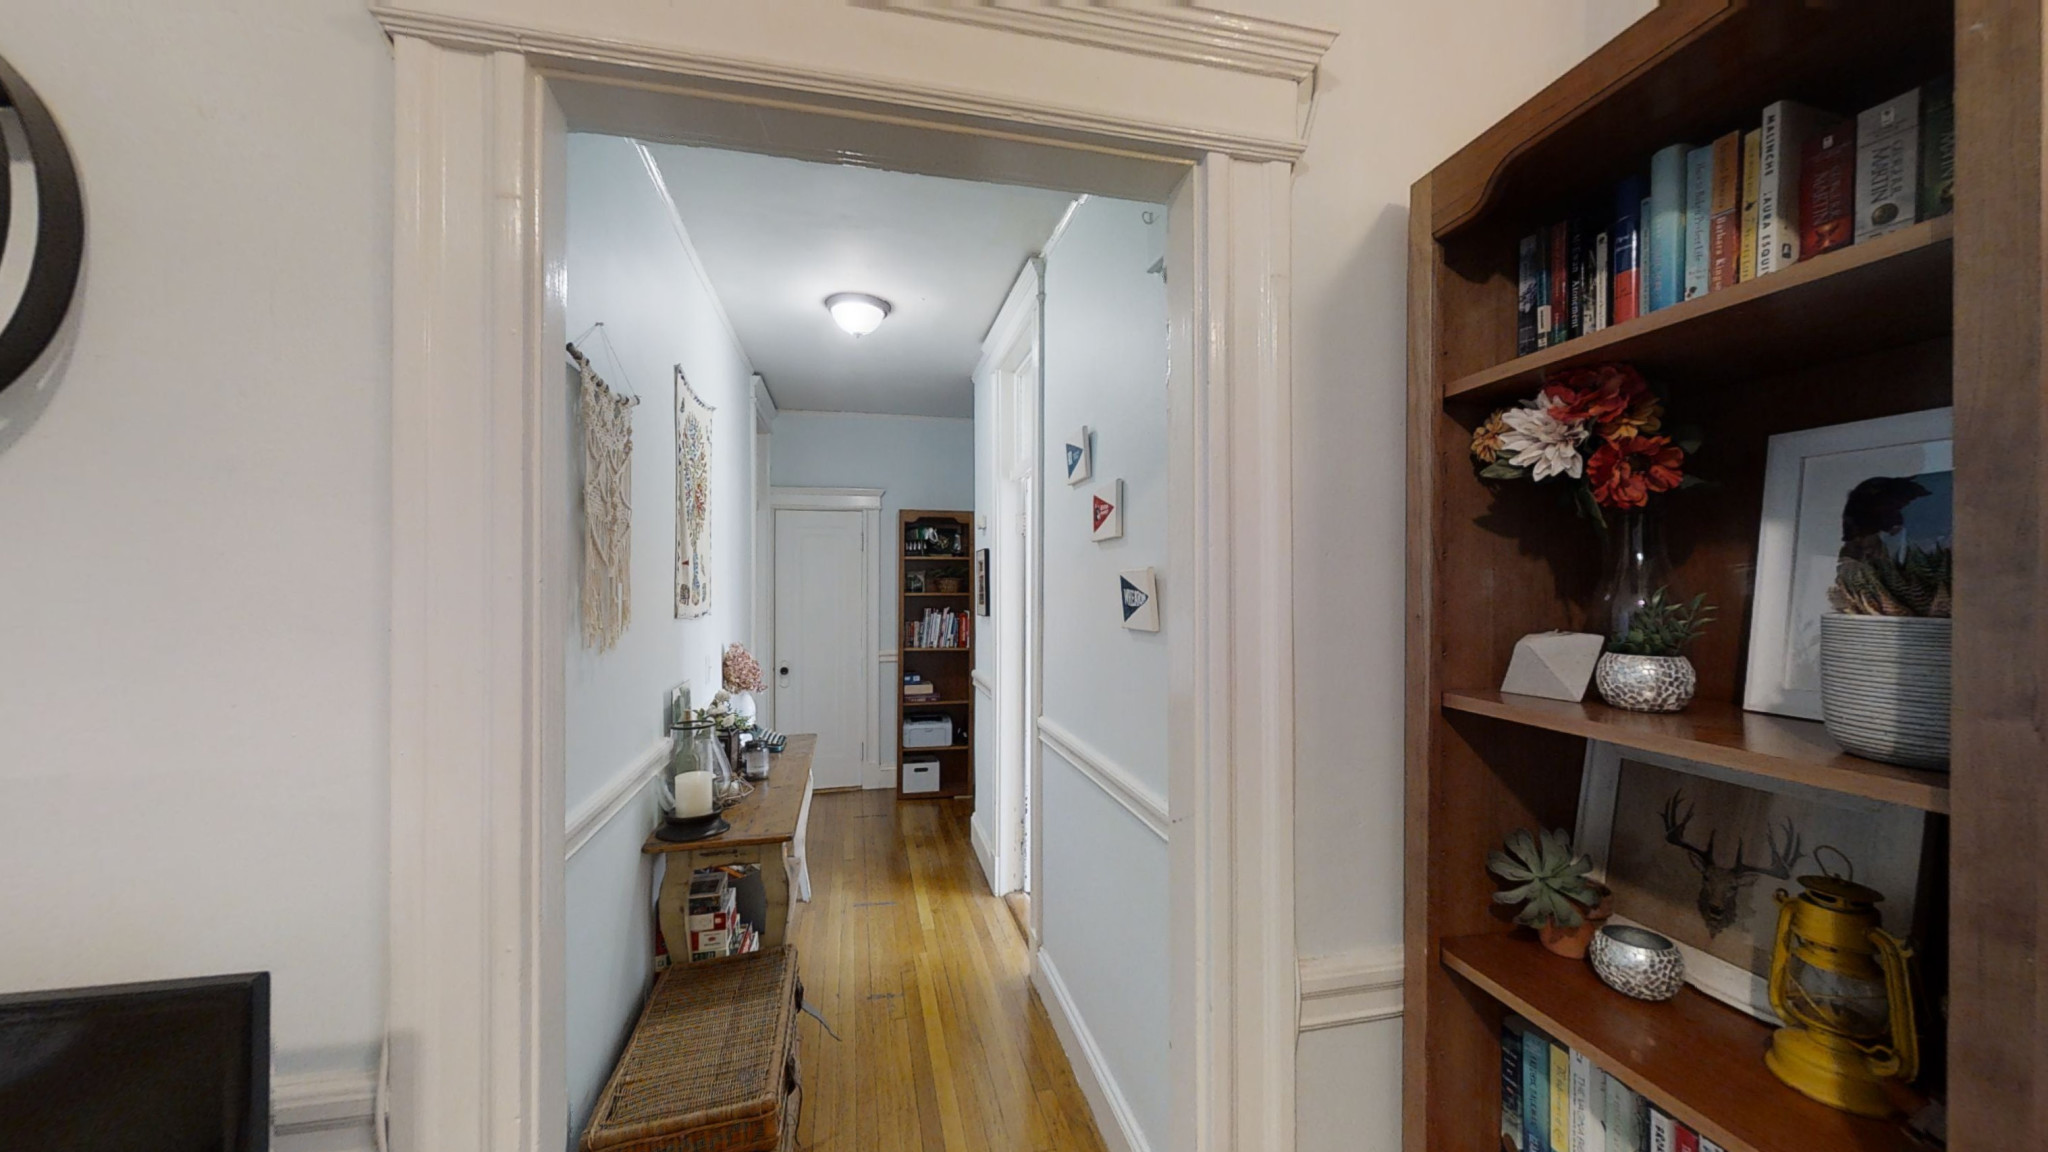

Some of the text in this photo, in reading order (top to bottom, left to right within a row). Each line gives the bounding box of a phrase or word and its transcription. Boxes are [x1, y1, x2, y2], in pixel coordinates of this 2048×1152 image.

[1764, 114, 1774, 176] MALINCHE
[1871, 144, 1889, 204] MARTIN
[1715, 215, 1725, 255] Barbara
[1571, 277, 1579, 329] Atonement
